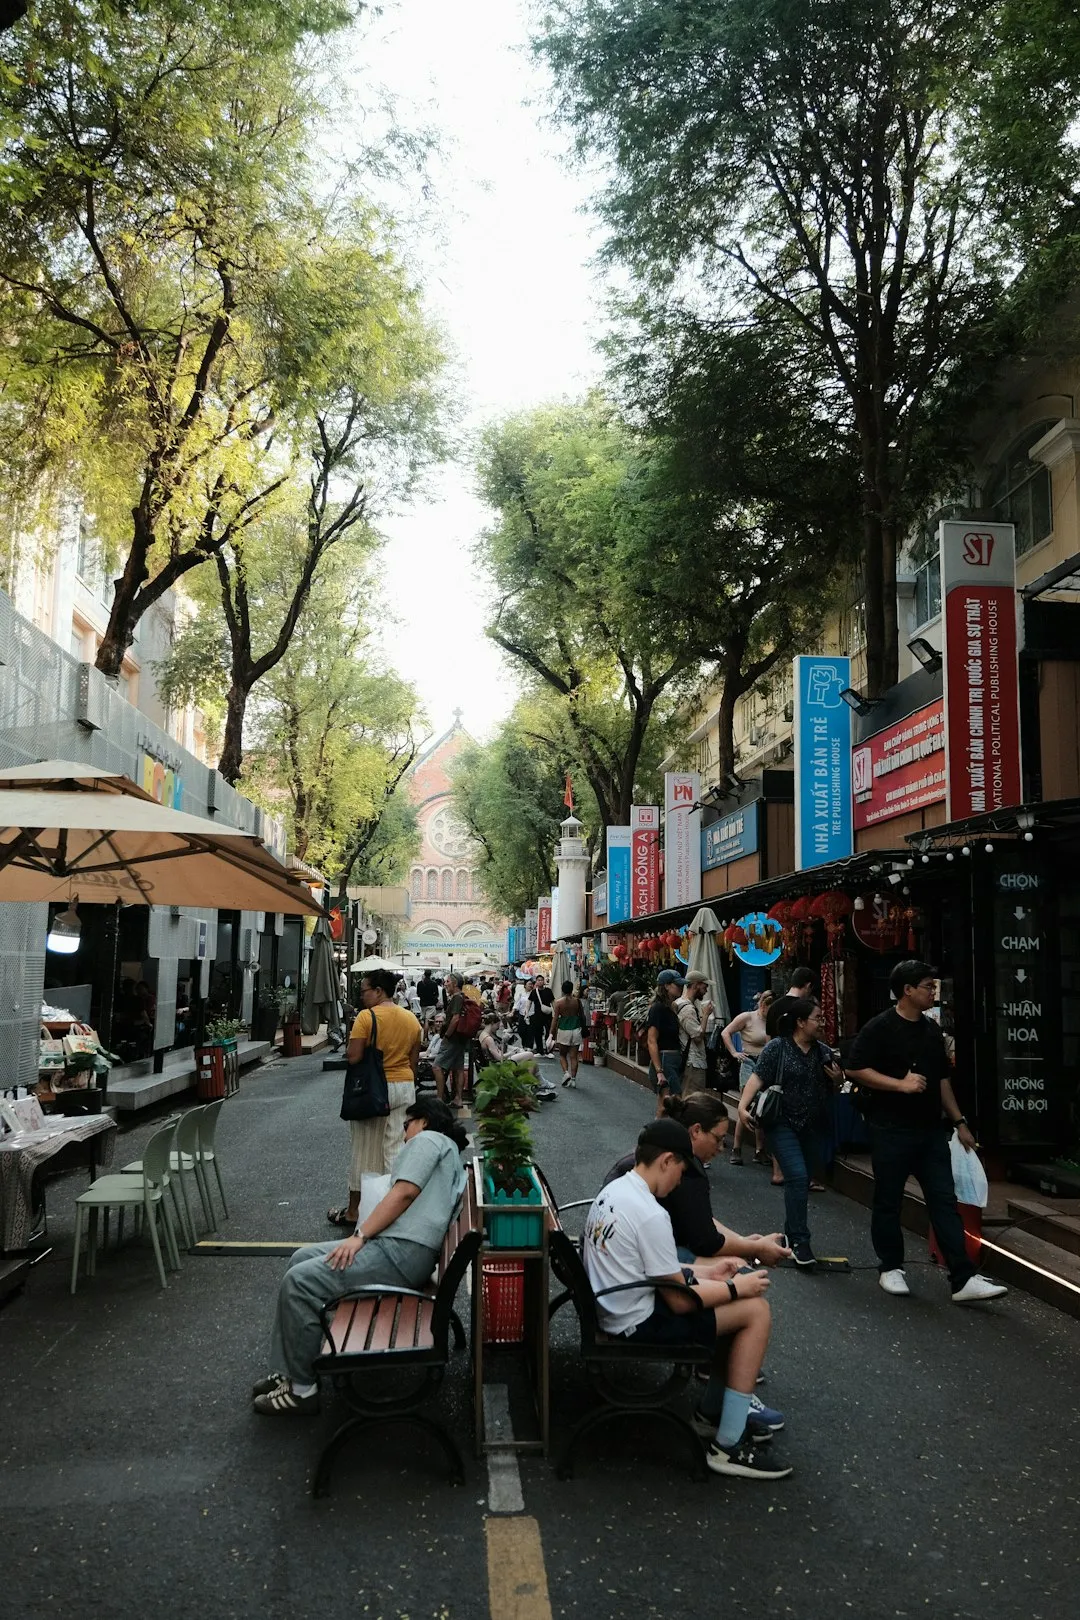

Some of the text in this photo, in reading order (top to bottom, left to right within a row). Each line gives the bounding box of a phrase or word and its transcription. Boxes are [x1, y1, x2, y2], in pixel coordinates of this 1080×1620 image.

[963, 532, 994, 566] ST
[964, 598, 985, 811] NHÀ XUẤT BẢN CHÍNH TRỊ QUỐC GIA SỰ THẬT
[988, 600, 1003, 811] NATIONAL POLITICAL PUBLISHING HOUSE
[674, 785, 692, 800] PN
[810, 717, 829, 853] NHÀ XUẤT BẢN TRẺ
[831, 737, 841, 836] TRE PUBLISHING HOUSE
[634, 832, 648, 916] SÁCH ĐÔNG A
[1000, 873, 1038, 890] CHỌN
[1001, 936, 1040, 953] CHẠM
[1003, 1000, 1042, 1019] NHẬN
[1007, 1028, 1039, 1041] HOA
[1004, 1077, 1044, 1090] KHÔNG
[1002, 1094, 1048, 1113] CẦN ĐỢI
